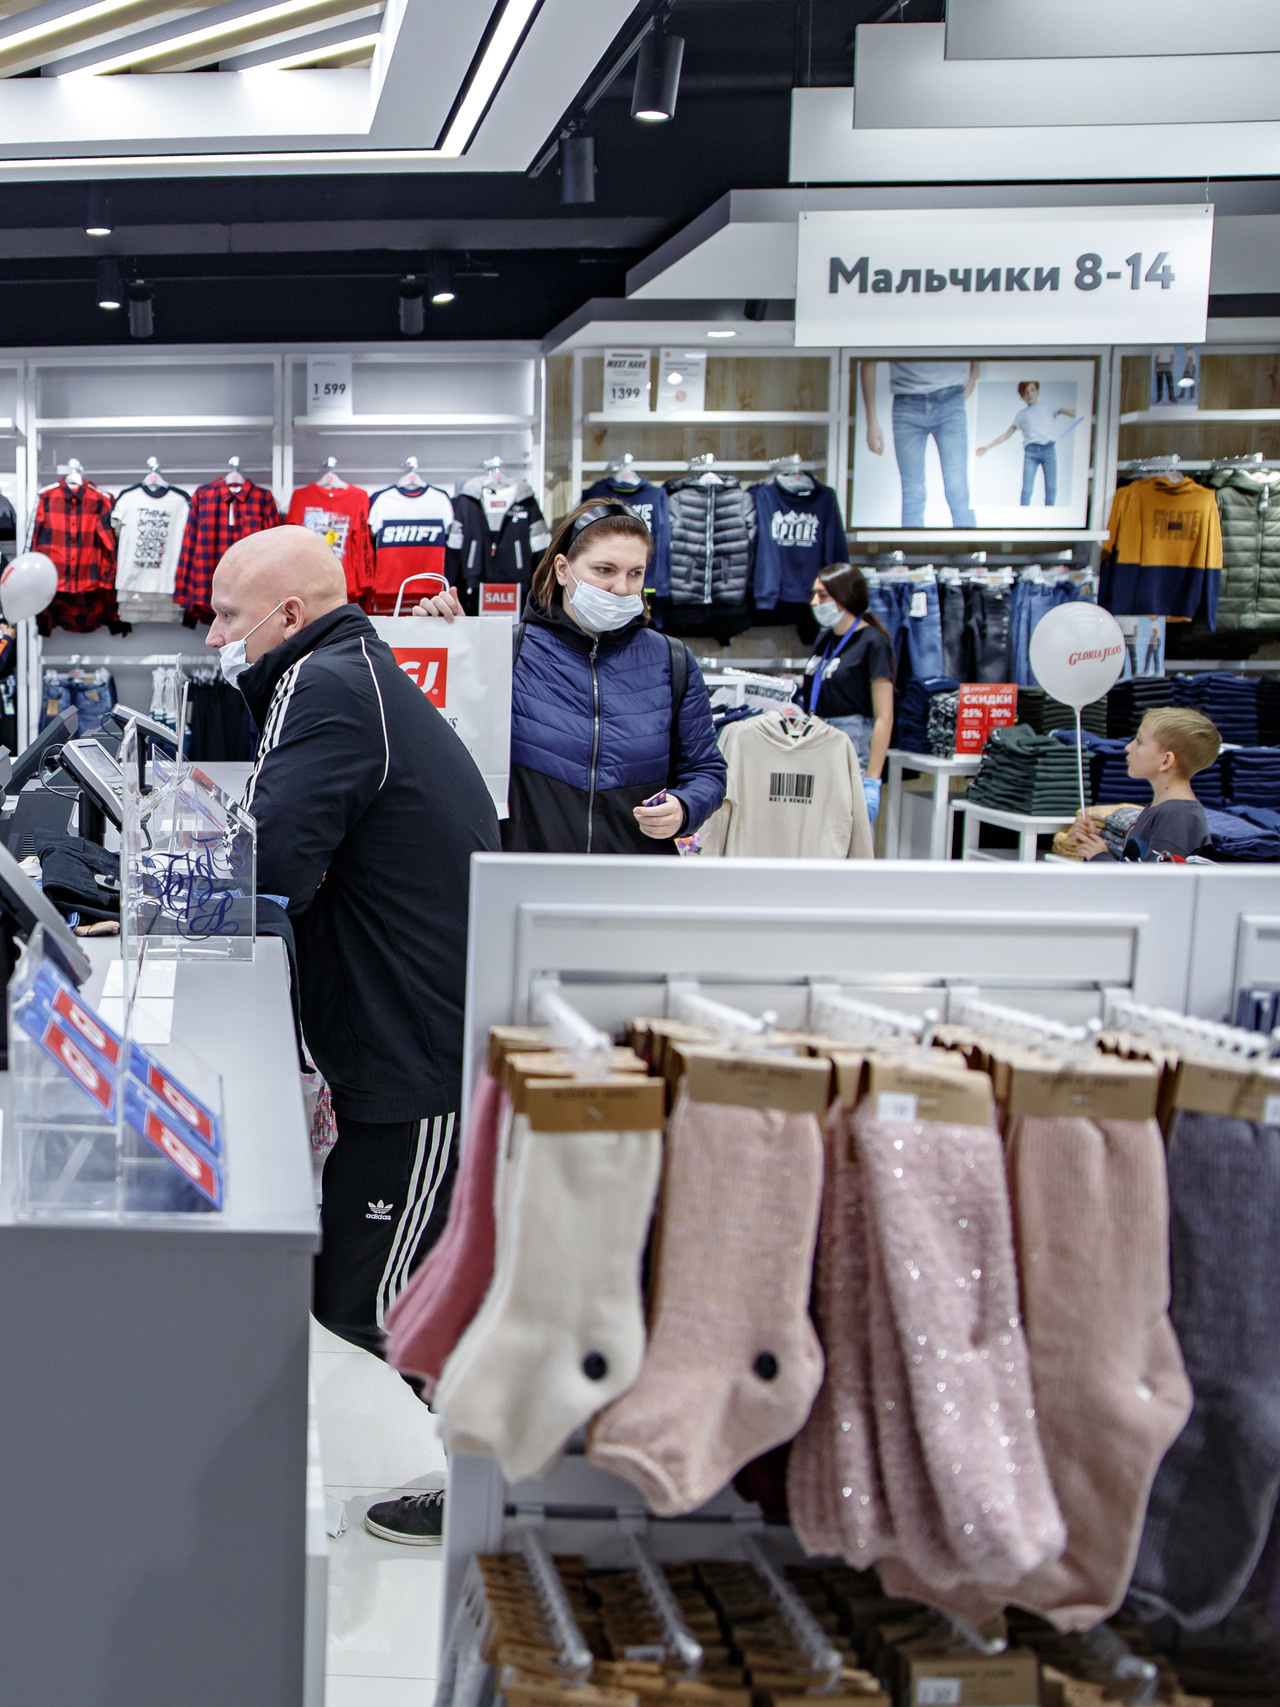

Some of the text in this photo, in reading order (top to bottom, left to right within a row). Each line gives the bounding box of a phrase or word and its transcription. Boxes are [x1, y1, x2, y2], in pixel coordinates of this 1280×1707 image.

[828, 251, 1176, 294] Мальчики 8-14
[611, 387, 640, 399] 1399
[382, 525, 443, 543] SHIFT
[484, 591, 515, 603] SALE
[1068, 645, 1121, 666] GLORIA JEANS
[962, 694, 1013, 706] СКИДКИ
[365, 1213, 392, 1221] adidas
